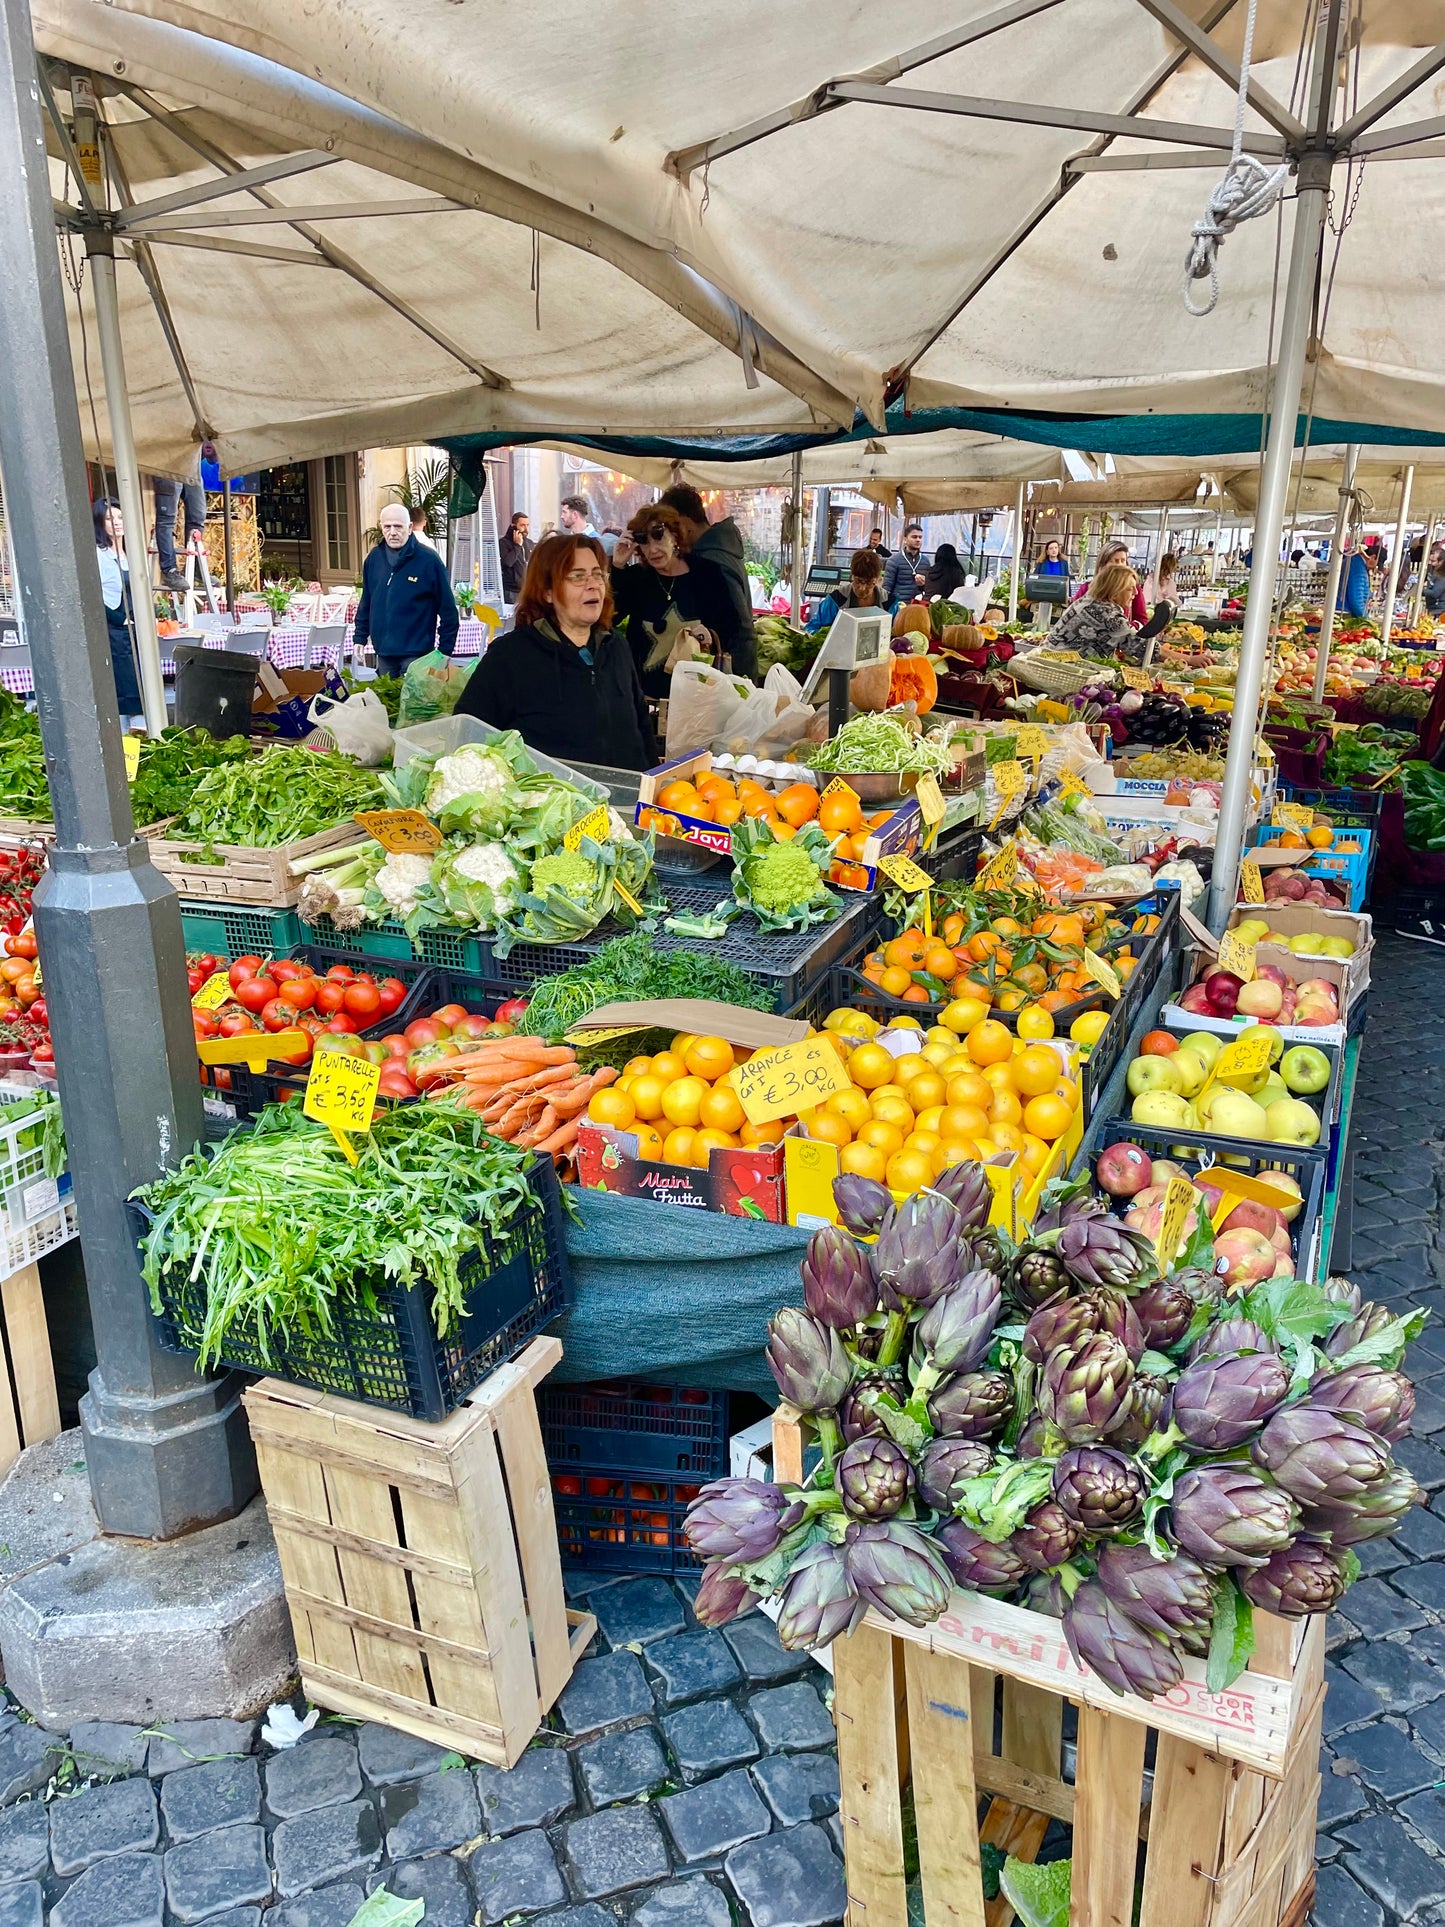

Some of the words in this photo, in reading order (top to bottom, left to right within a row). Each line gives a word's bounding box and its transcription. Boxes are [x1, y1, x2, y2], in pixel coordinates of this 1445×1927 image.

[1124, 781, 1167, 791] MOCCIA
[367, 816, 416, 828] CAVOLFIORE
[689, 825, 729, 850] Javi
[319, 1052, 376, 1078] PUNTARELLE
[740, 1049, 793, 1083] ARANCE
[817, 1077, 837, 1093] KG
[351, 1111, 365, 1123] KG
[638, 1172, 693, 1189] Maini
[653, 1188, 707, 1206] Frutta
[1197, 1691, 1253, 1713] CUOR
